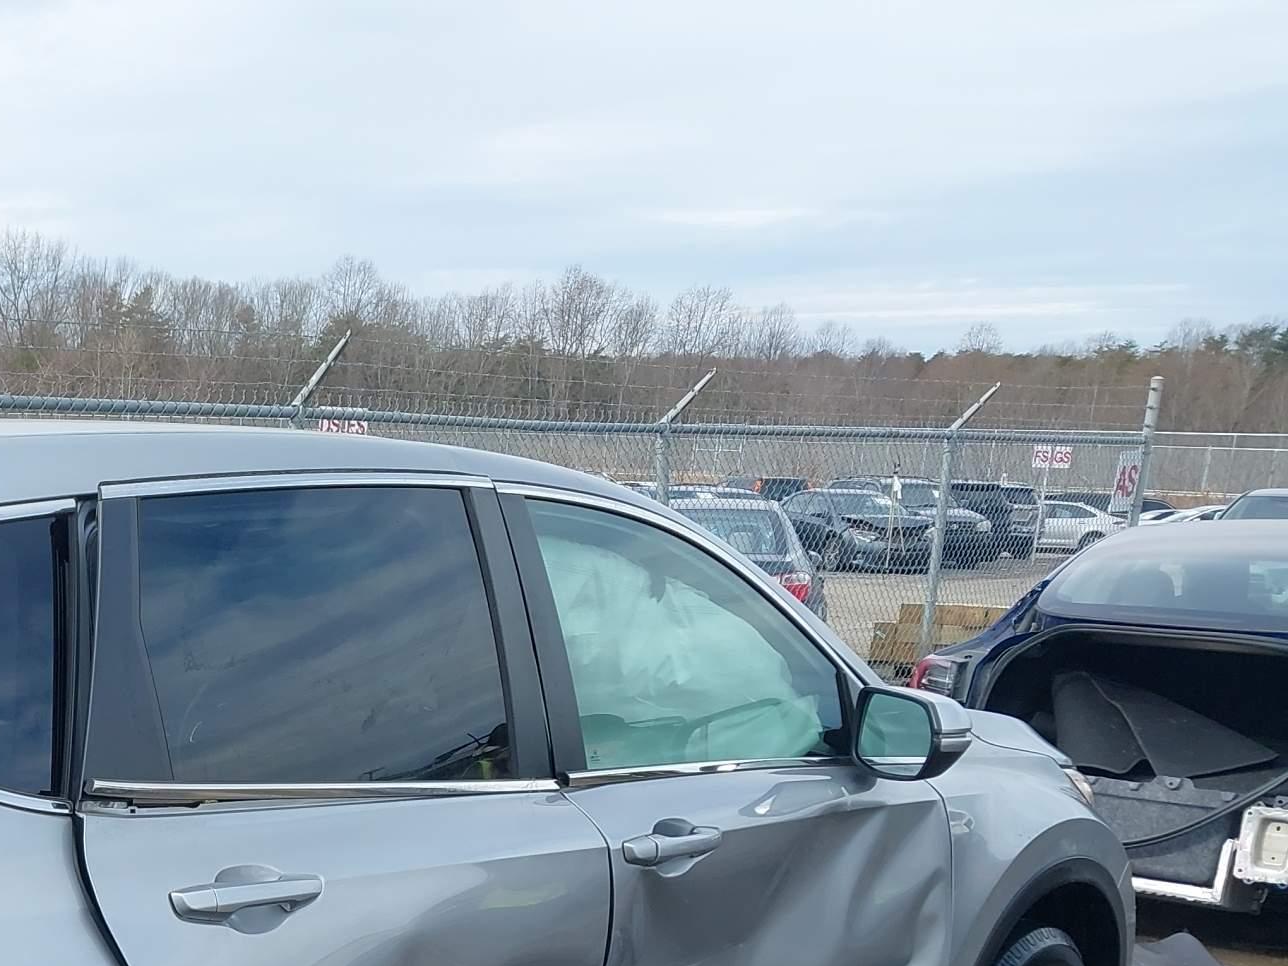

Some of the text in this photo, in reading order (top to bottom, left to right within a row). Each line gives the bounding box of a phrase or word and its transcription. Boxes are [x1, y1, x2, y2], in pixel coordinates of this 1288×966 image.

[1034, 450, 1049, 463] FS
[1054, 451, 1072, 463] GS
[1113, 464, 1139, 498] AS
